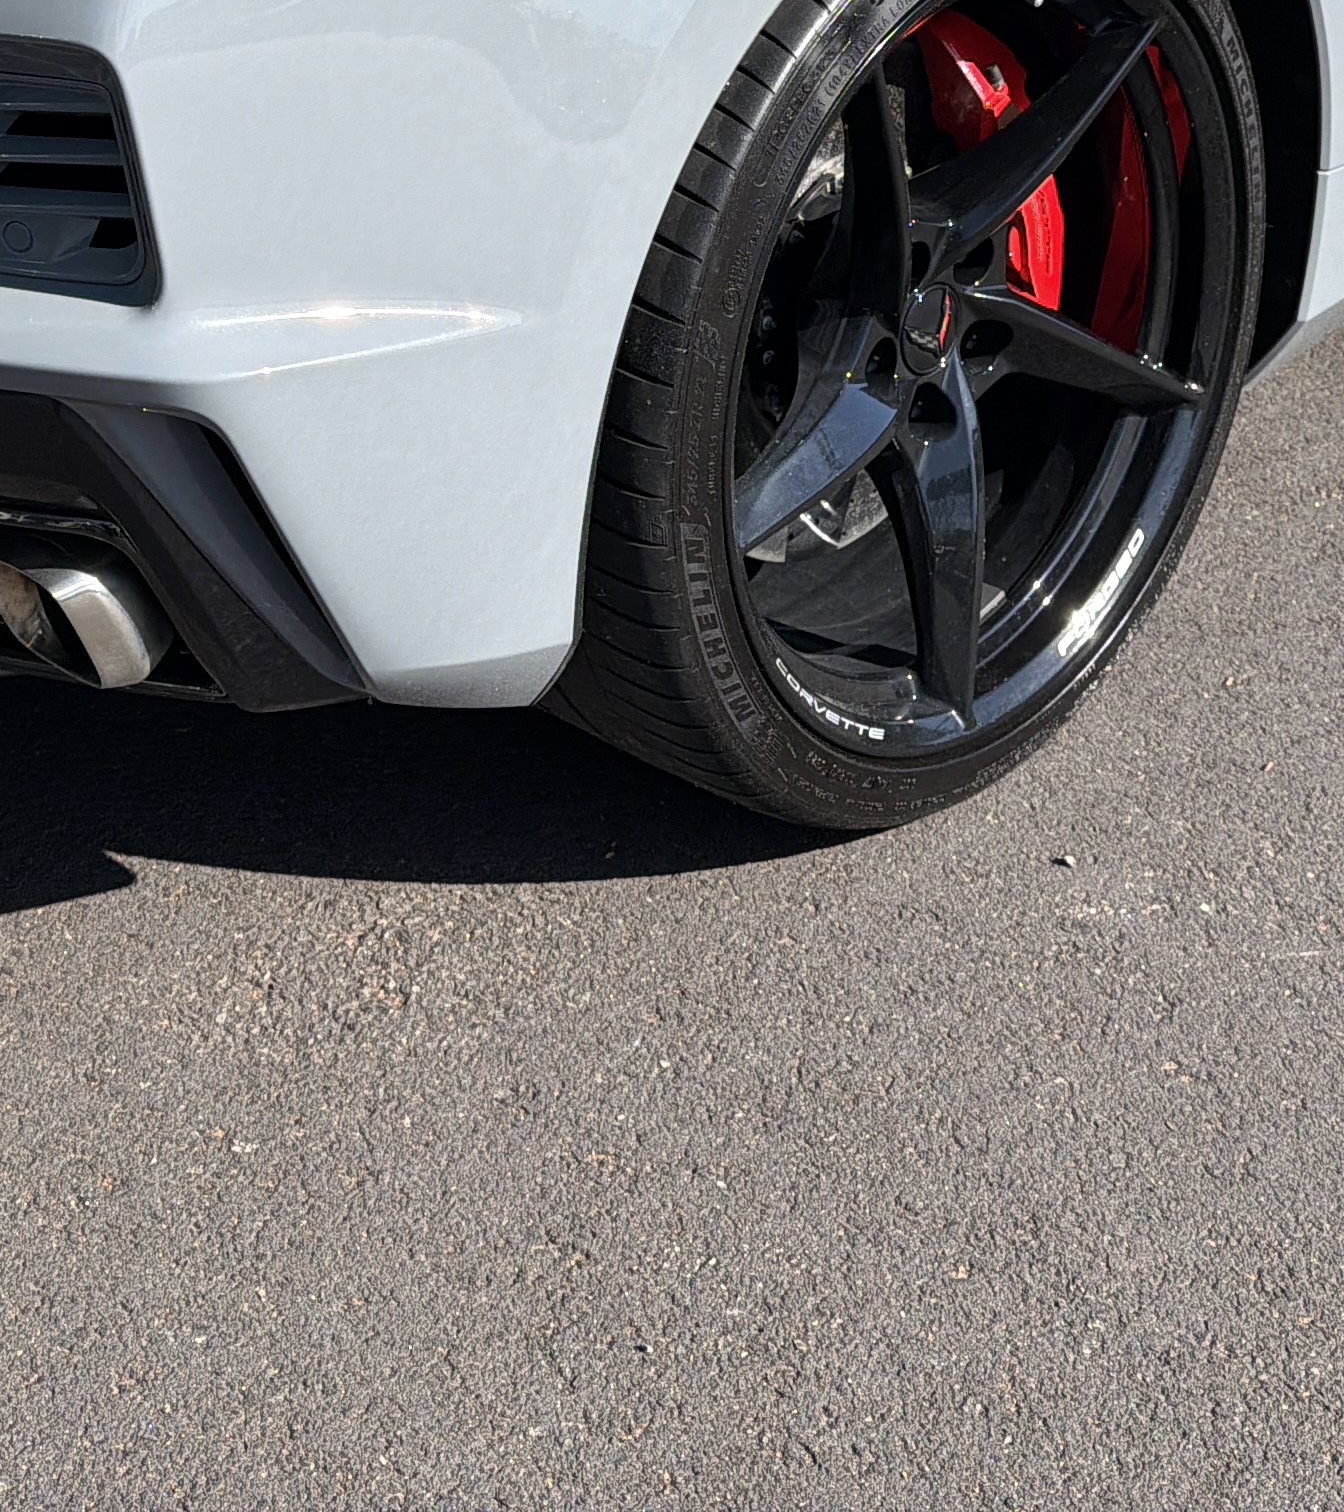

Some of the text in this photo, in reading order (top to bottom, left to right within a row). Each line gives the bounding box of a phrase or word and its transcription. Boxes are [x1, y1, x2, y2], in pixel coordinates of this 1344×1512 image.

[1224, 36, 1265, 205] MICHELIN
[685, 525, 757, 731] MICHELIN
[1058, 528, 1145, 657] FORGED
[776, 657, 885, 741] CORVETTE
